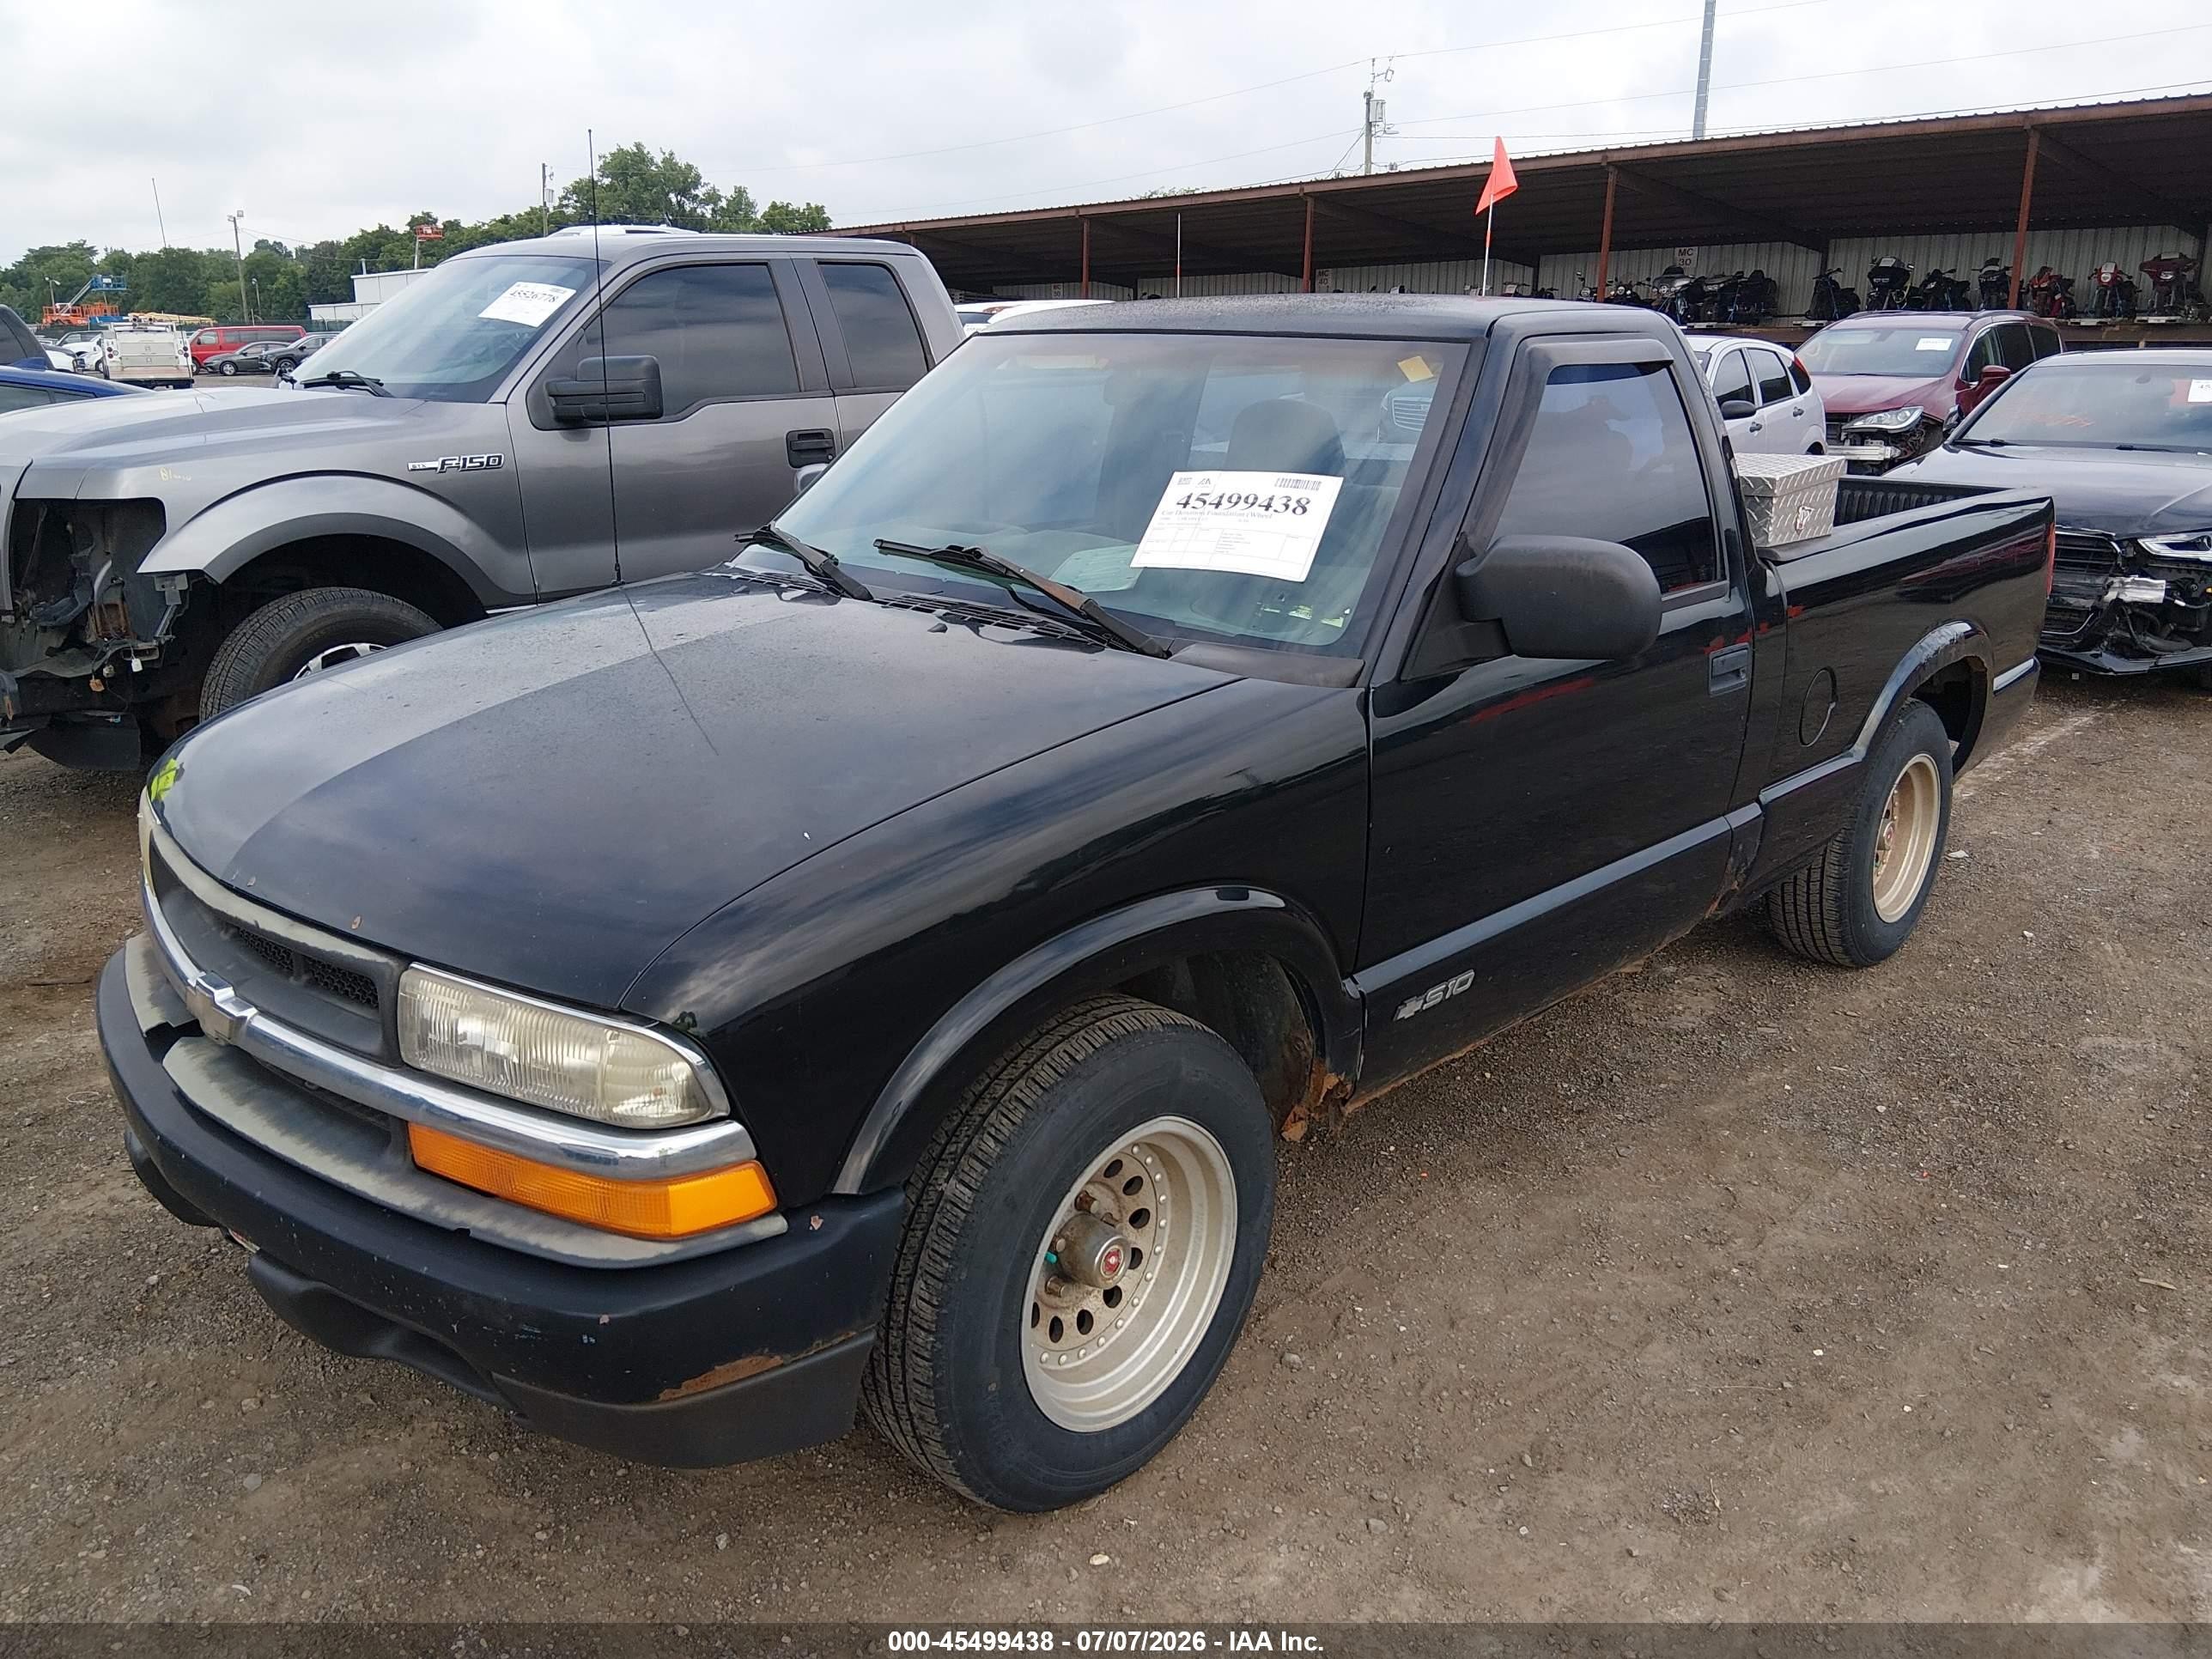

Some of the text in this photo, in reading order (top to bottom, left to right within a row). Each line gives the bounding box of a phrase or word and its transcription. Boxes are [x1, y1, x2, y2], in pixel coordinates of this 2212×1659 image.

[1678, 247, 1693, 257] MC
[1678, 258, 1692, 266] 30
[438, 453, 505, 473] F-150
[1176, 492, 1312, 516] 45499438
[1422, 969, 1475, 1011] S10
